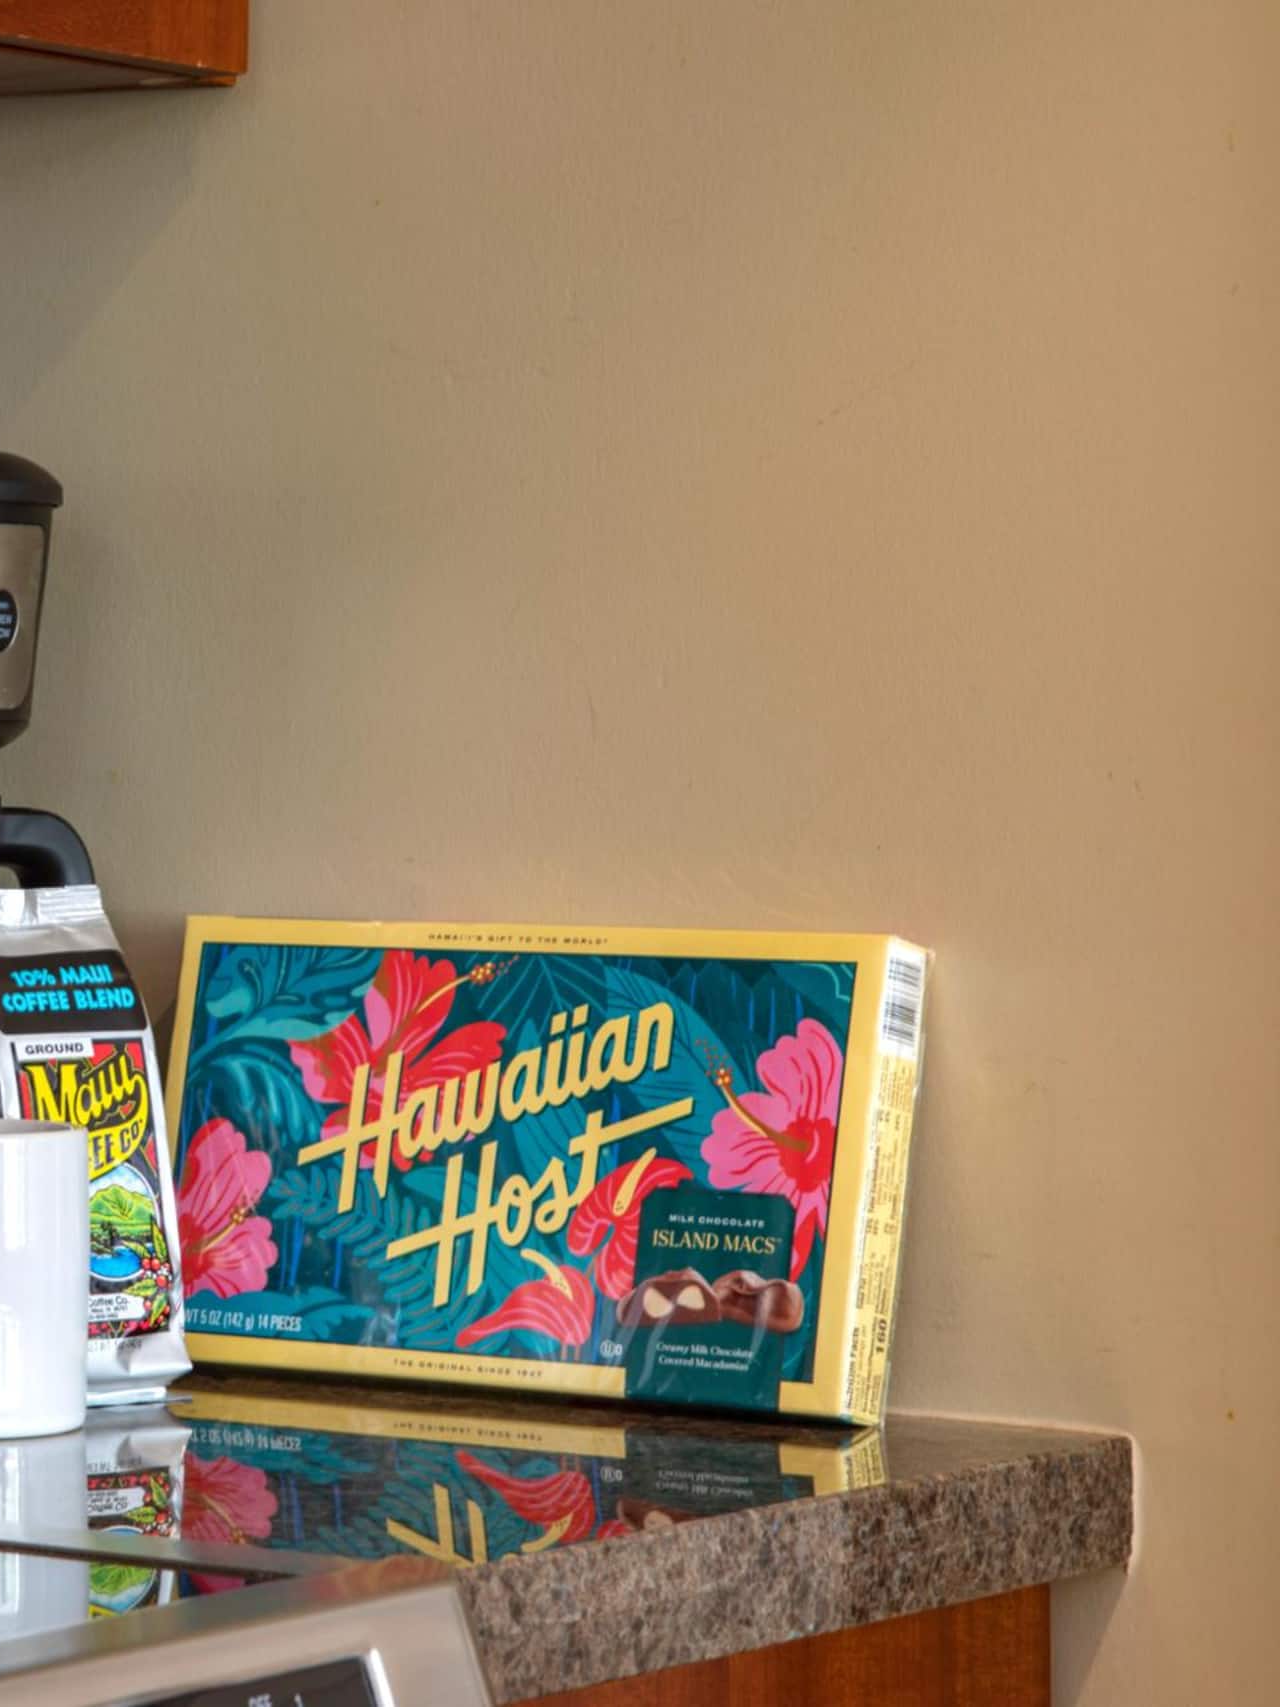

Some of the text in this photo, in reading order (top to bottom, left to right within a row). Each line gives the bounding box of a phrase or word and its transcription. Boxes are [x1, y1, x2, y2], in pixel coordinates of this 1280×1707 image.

[538, 936, 558, 944] THE
[10, 964, 114, 988] 10% MAUI
[1, 986, 136, 1014] COFFEE BLEND
[24, 1042, 85, 1056] GROUND
[23, 1053, 140, 1130] Maui
[297, 1001, 675, 1215] Hawaiian
[386, 1096, 694, 1308] Host
[668, 1213, 765, 1228] MILK CHOCOLATE
[652, 1228, 720, 1251] ISLAND
[208, 1309, 222, 1326] OZ
[223, 1311, 244, 1329] (142
[258, 1313, 268, 1330] 14
[269, 1314, 303, 1332] PIECES
[655, 1342, 754, 1359] Creamy Milk Chocolate
[393, 1358, 413, 1367] THE
[418, 1359, 471, 1372] ORIGINAL
[477, 1363, 511, 1375] SINCE
[658, 1354, 750, 1372] Covered Macadamias
